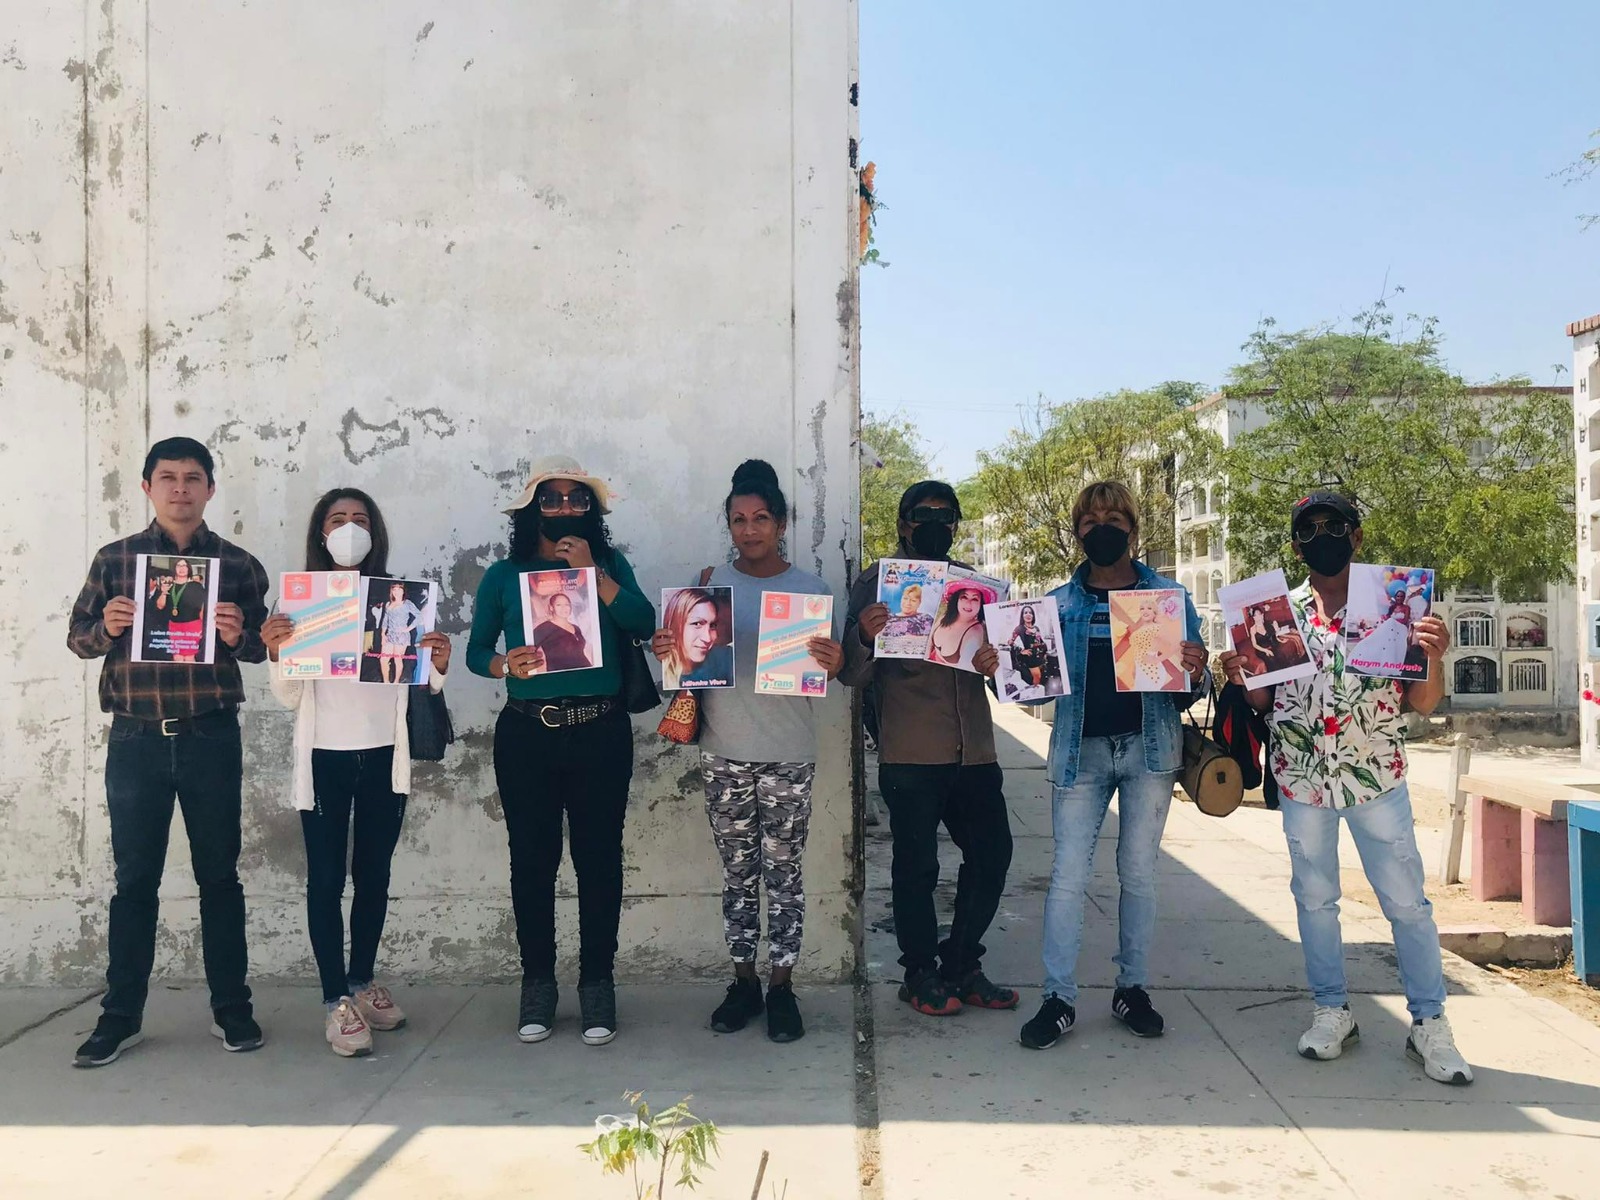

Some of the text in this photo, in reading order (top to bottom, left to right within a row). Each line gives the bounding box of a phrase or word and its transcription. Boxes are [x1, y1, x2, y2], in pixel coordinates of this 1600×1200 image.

[1580, 378, 1587, 394] H
[1580, 477, 1587, 492] F
[1581, 525, 1588, 541] E
[1381, 661, 1424, 673] Andrade
